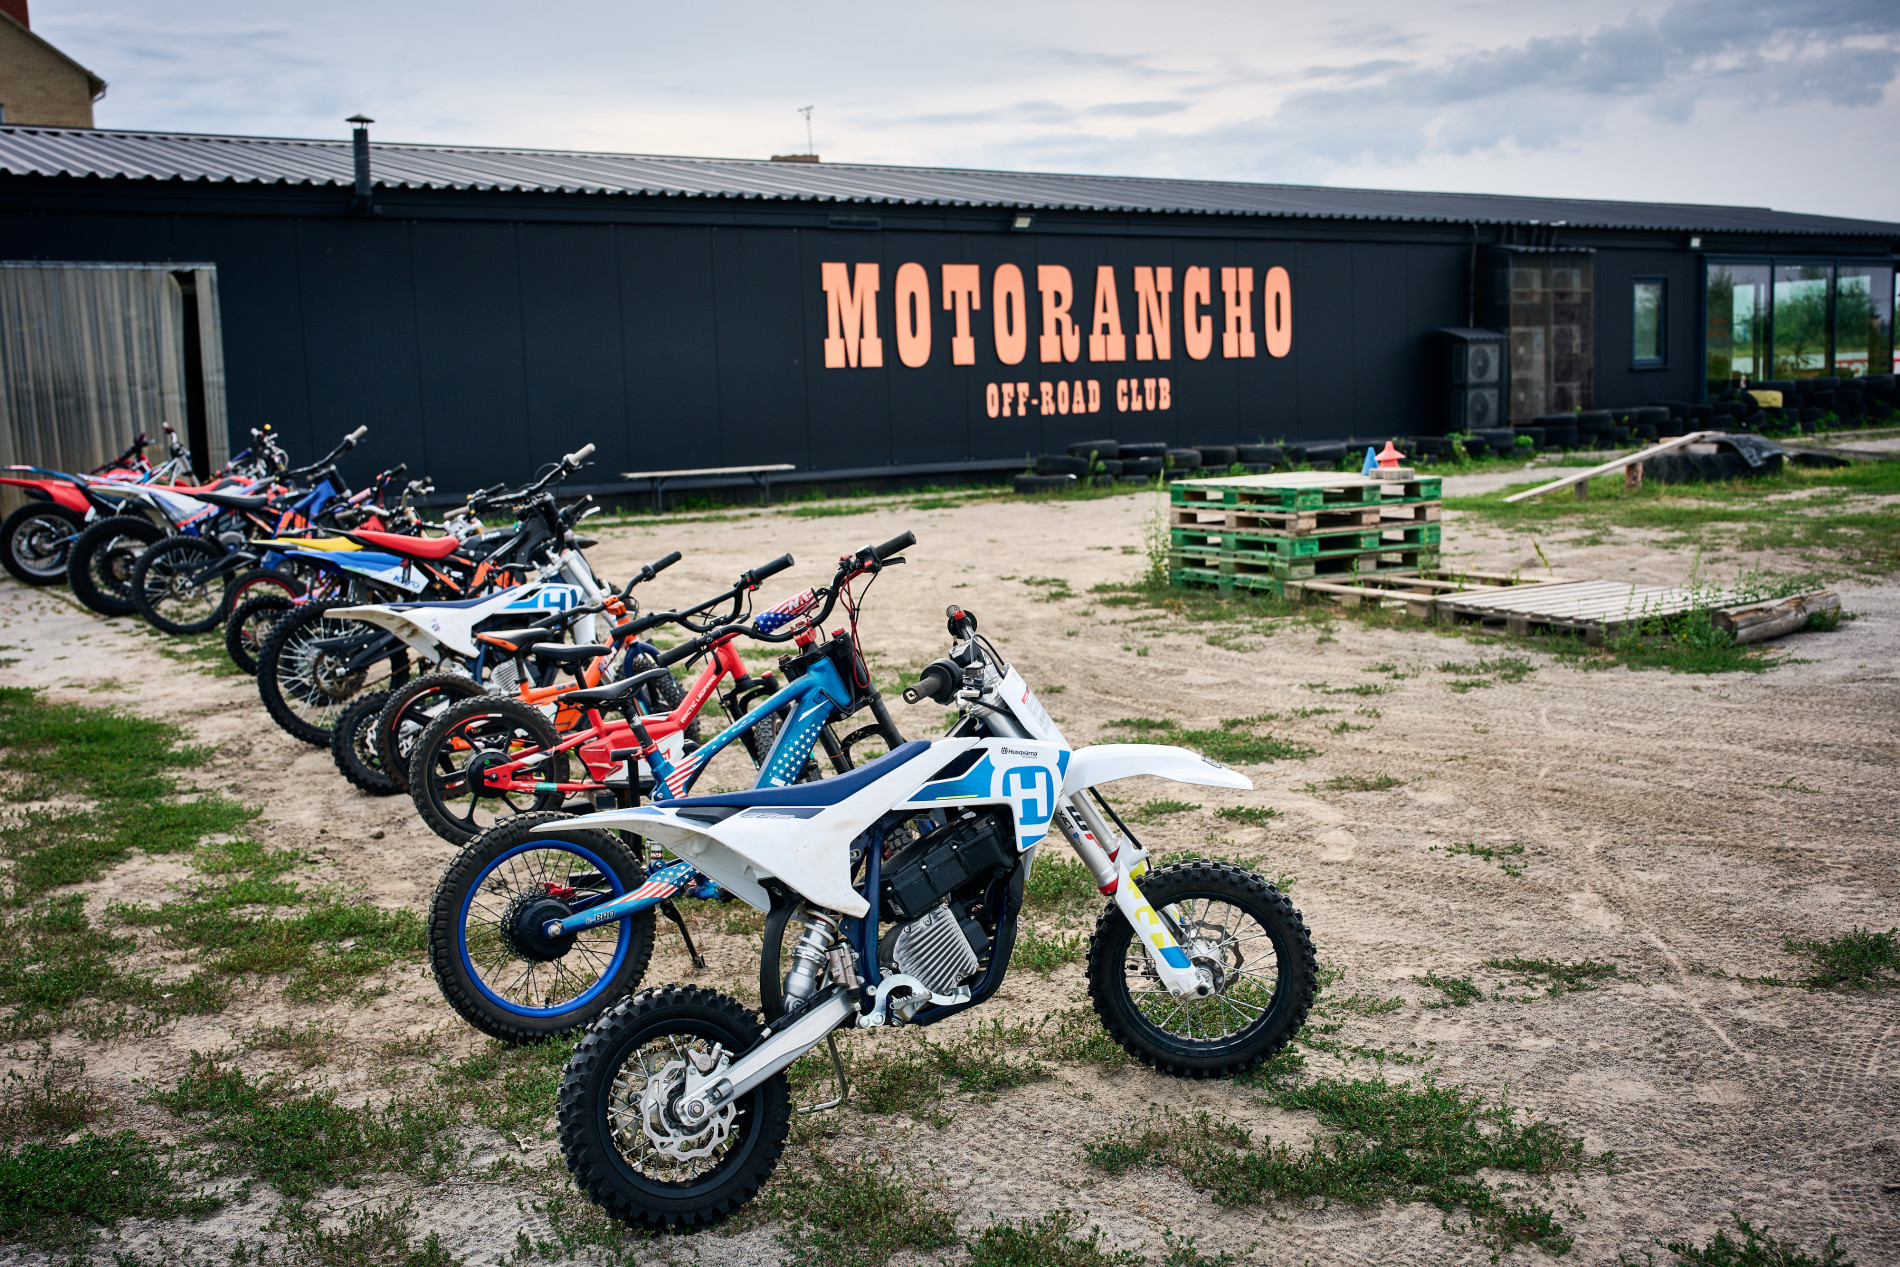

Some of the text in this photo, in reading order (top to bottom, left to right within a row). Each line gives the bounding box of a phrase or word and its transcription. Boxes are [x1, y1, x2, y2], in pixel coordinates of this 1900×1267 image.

[821, 262, 1293, 369] MOTORANCHO
[985, 377, 1172, 419] OFF-ROAD CLUB
[680, 674, 717, 724] ARCTIC LEOPARD
[1008, 749, 1038, 757] Husqvarna
[1057, 810, 1074, 830] XACT
[585, 910, 615, 925] e-BRO
